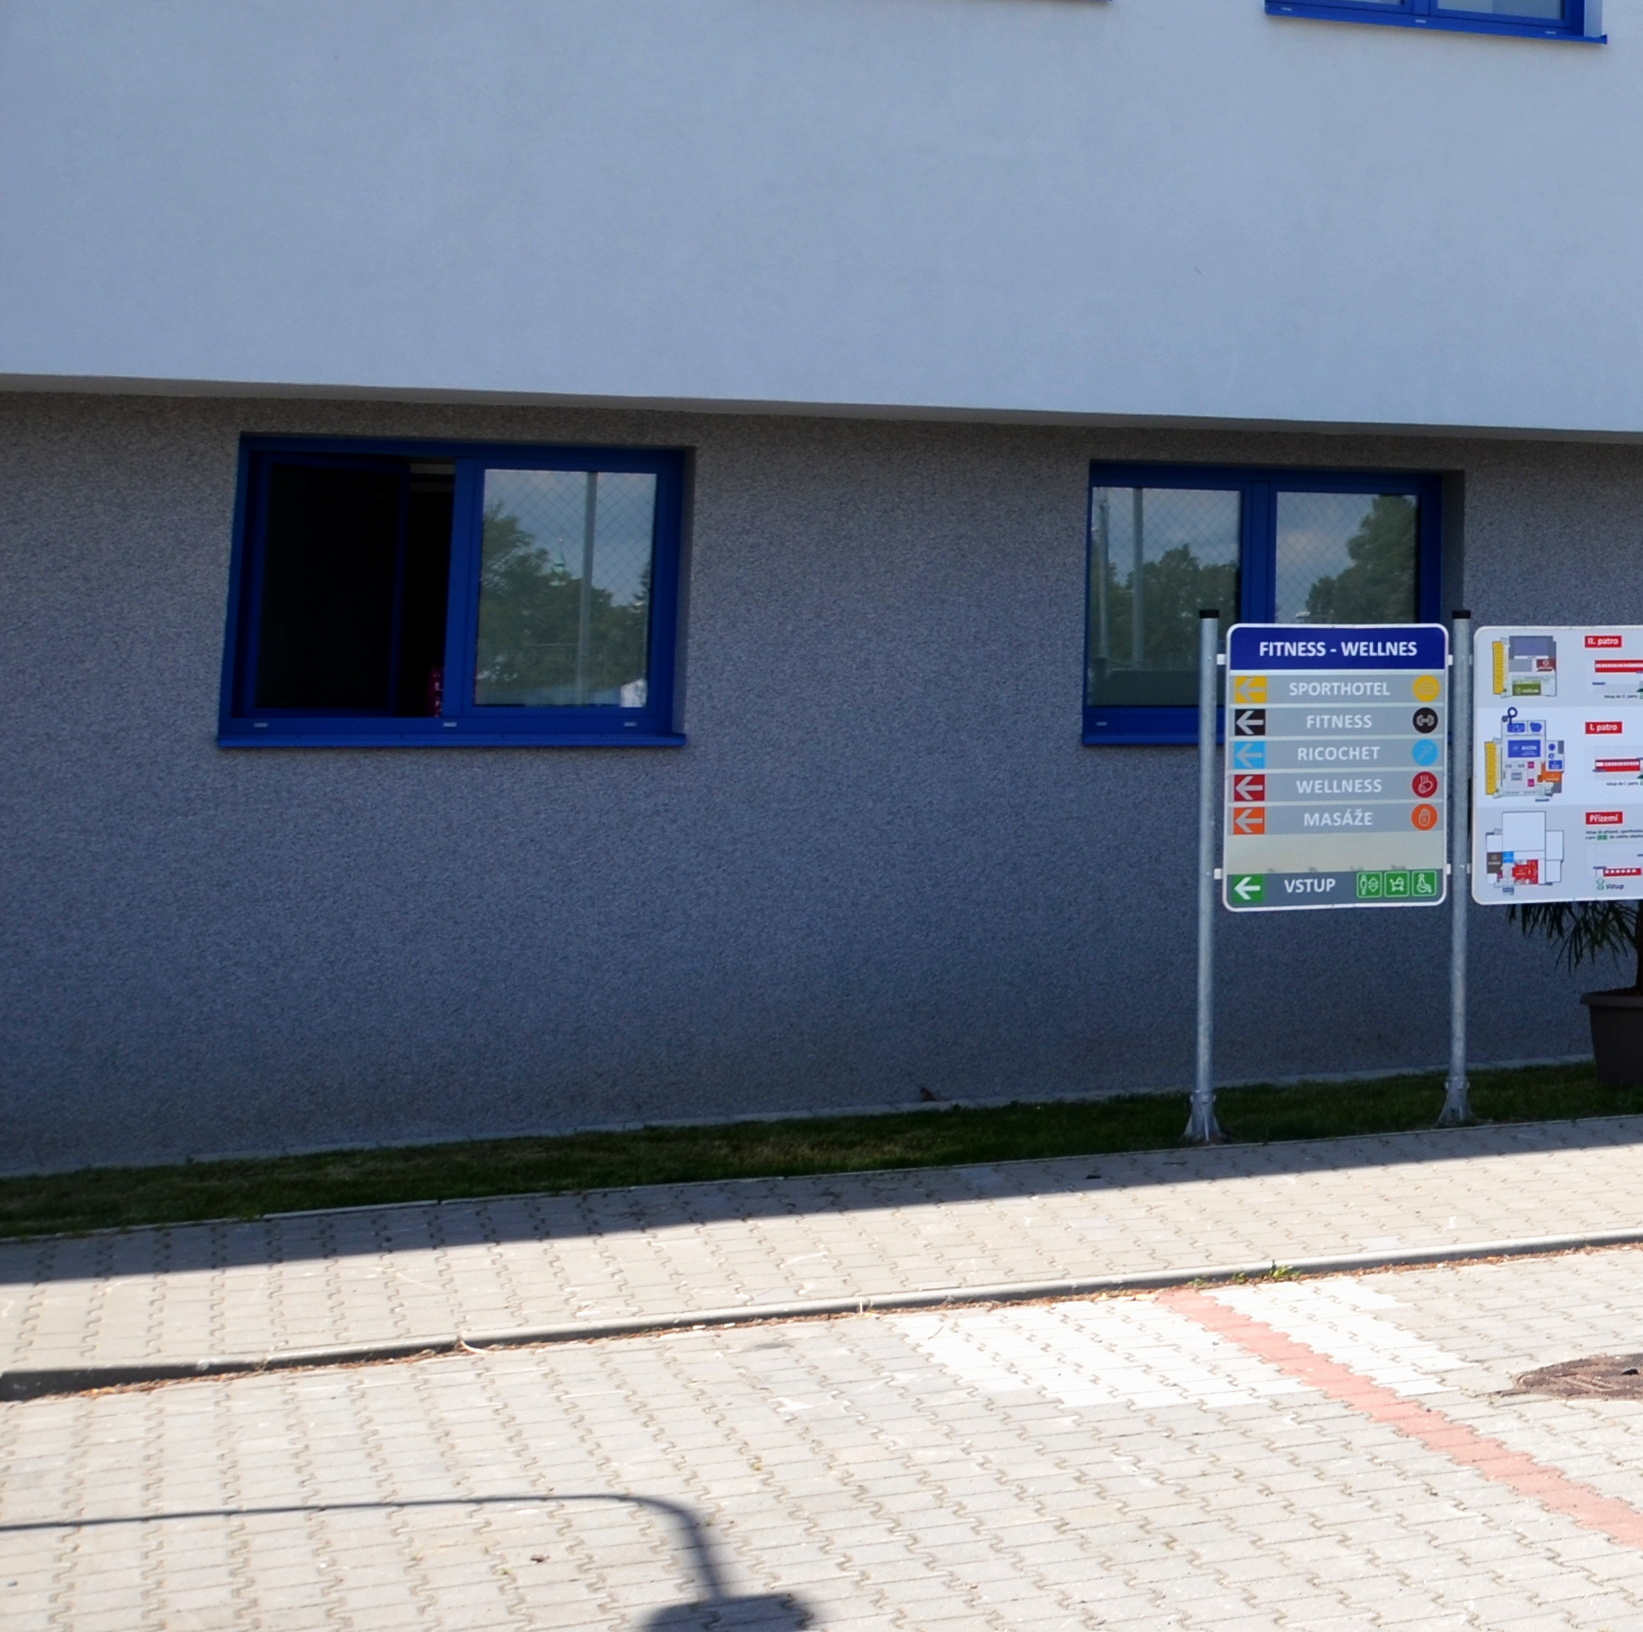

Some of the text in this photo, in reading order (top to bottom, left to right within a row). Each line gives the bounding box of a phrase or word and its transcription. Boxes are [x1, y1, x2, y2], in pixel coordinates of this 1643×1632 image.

[1259, 641, 1326, 657] FITNESS
[1341, 641, 1418, 656] WELLNES
[1289, 682, 1390, 696] SPORTHOTEL
[1306, 714, 1372, 728] FITNESS
[1297, 746, 1380, 761] RICOCHET
[1296, 779, 1382, 793] WELLNESS
[1303, 808, 1373, 826] MASÁŽE
[1284, 878, 1336, 893] VSTUP
